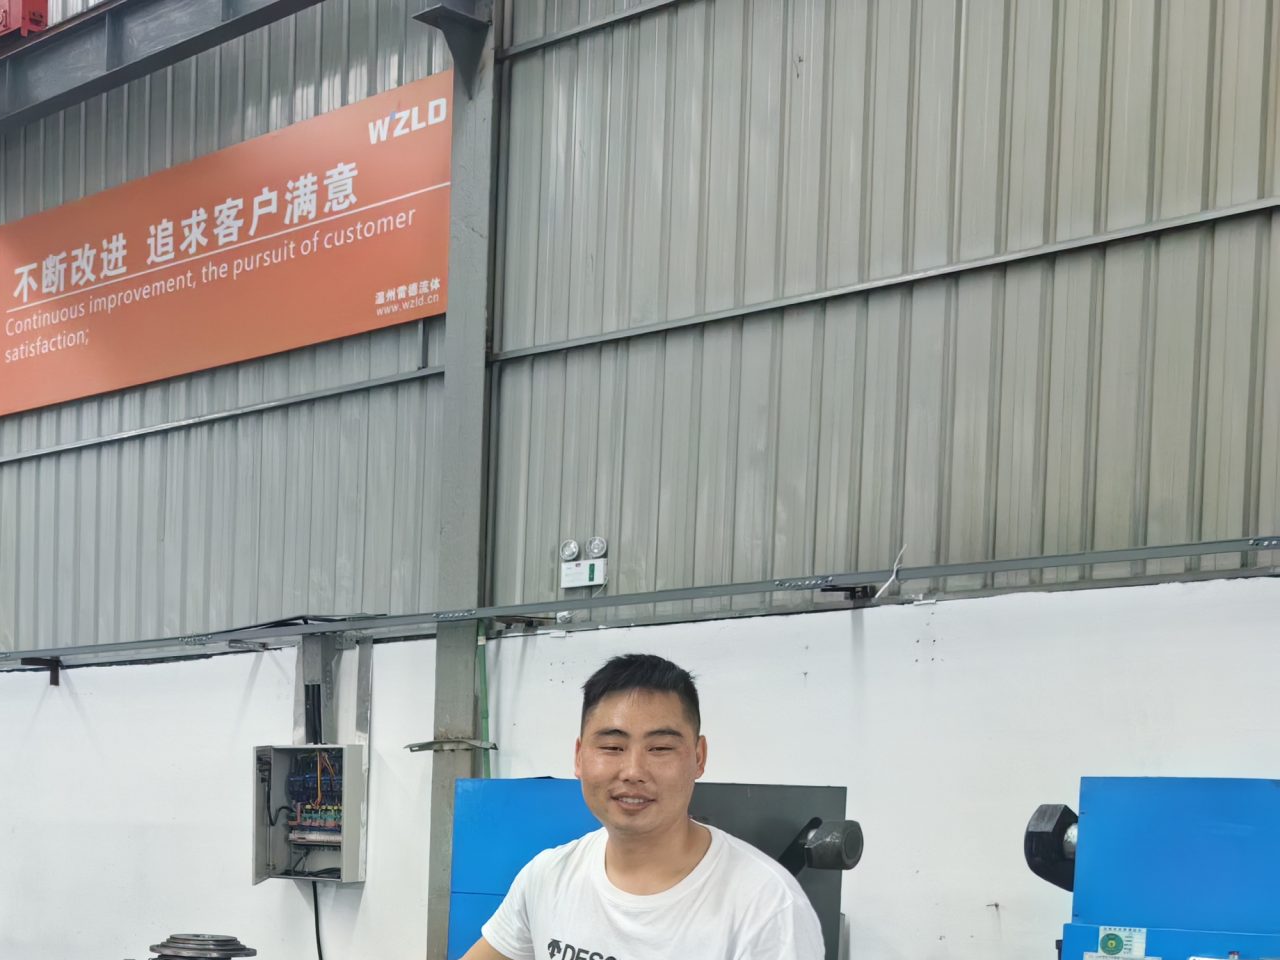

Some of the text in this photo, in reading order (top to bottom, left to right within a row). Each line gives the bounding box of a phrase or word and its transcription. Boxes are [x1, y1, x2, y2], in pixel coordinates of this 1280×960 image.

[368, 97, 447, 145] WZLD
[12, 162, 360, 303] 不断改进 追求客户满意
[5, 208, 416, 337] Continuous improvement, the pursuit of customer
[376, 294, 440, 317] www.wzld.cn
[4, 328, 90, 364] satisfaction;
